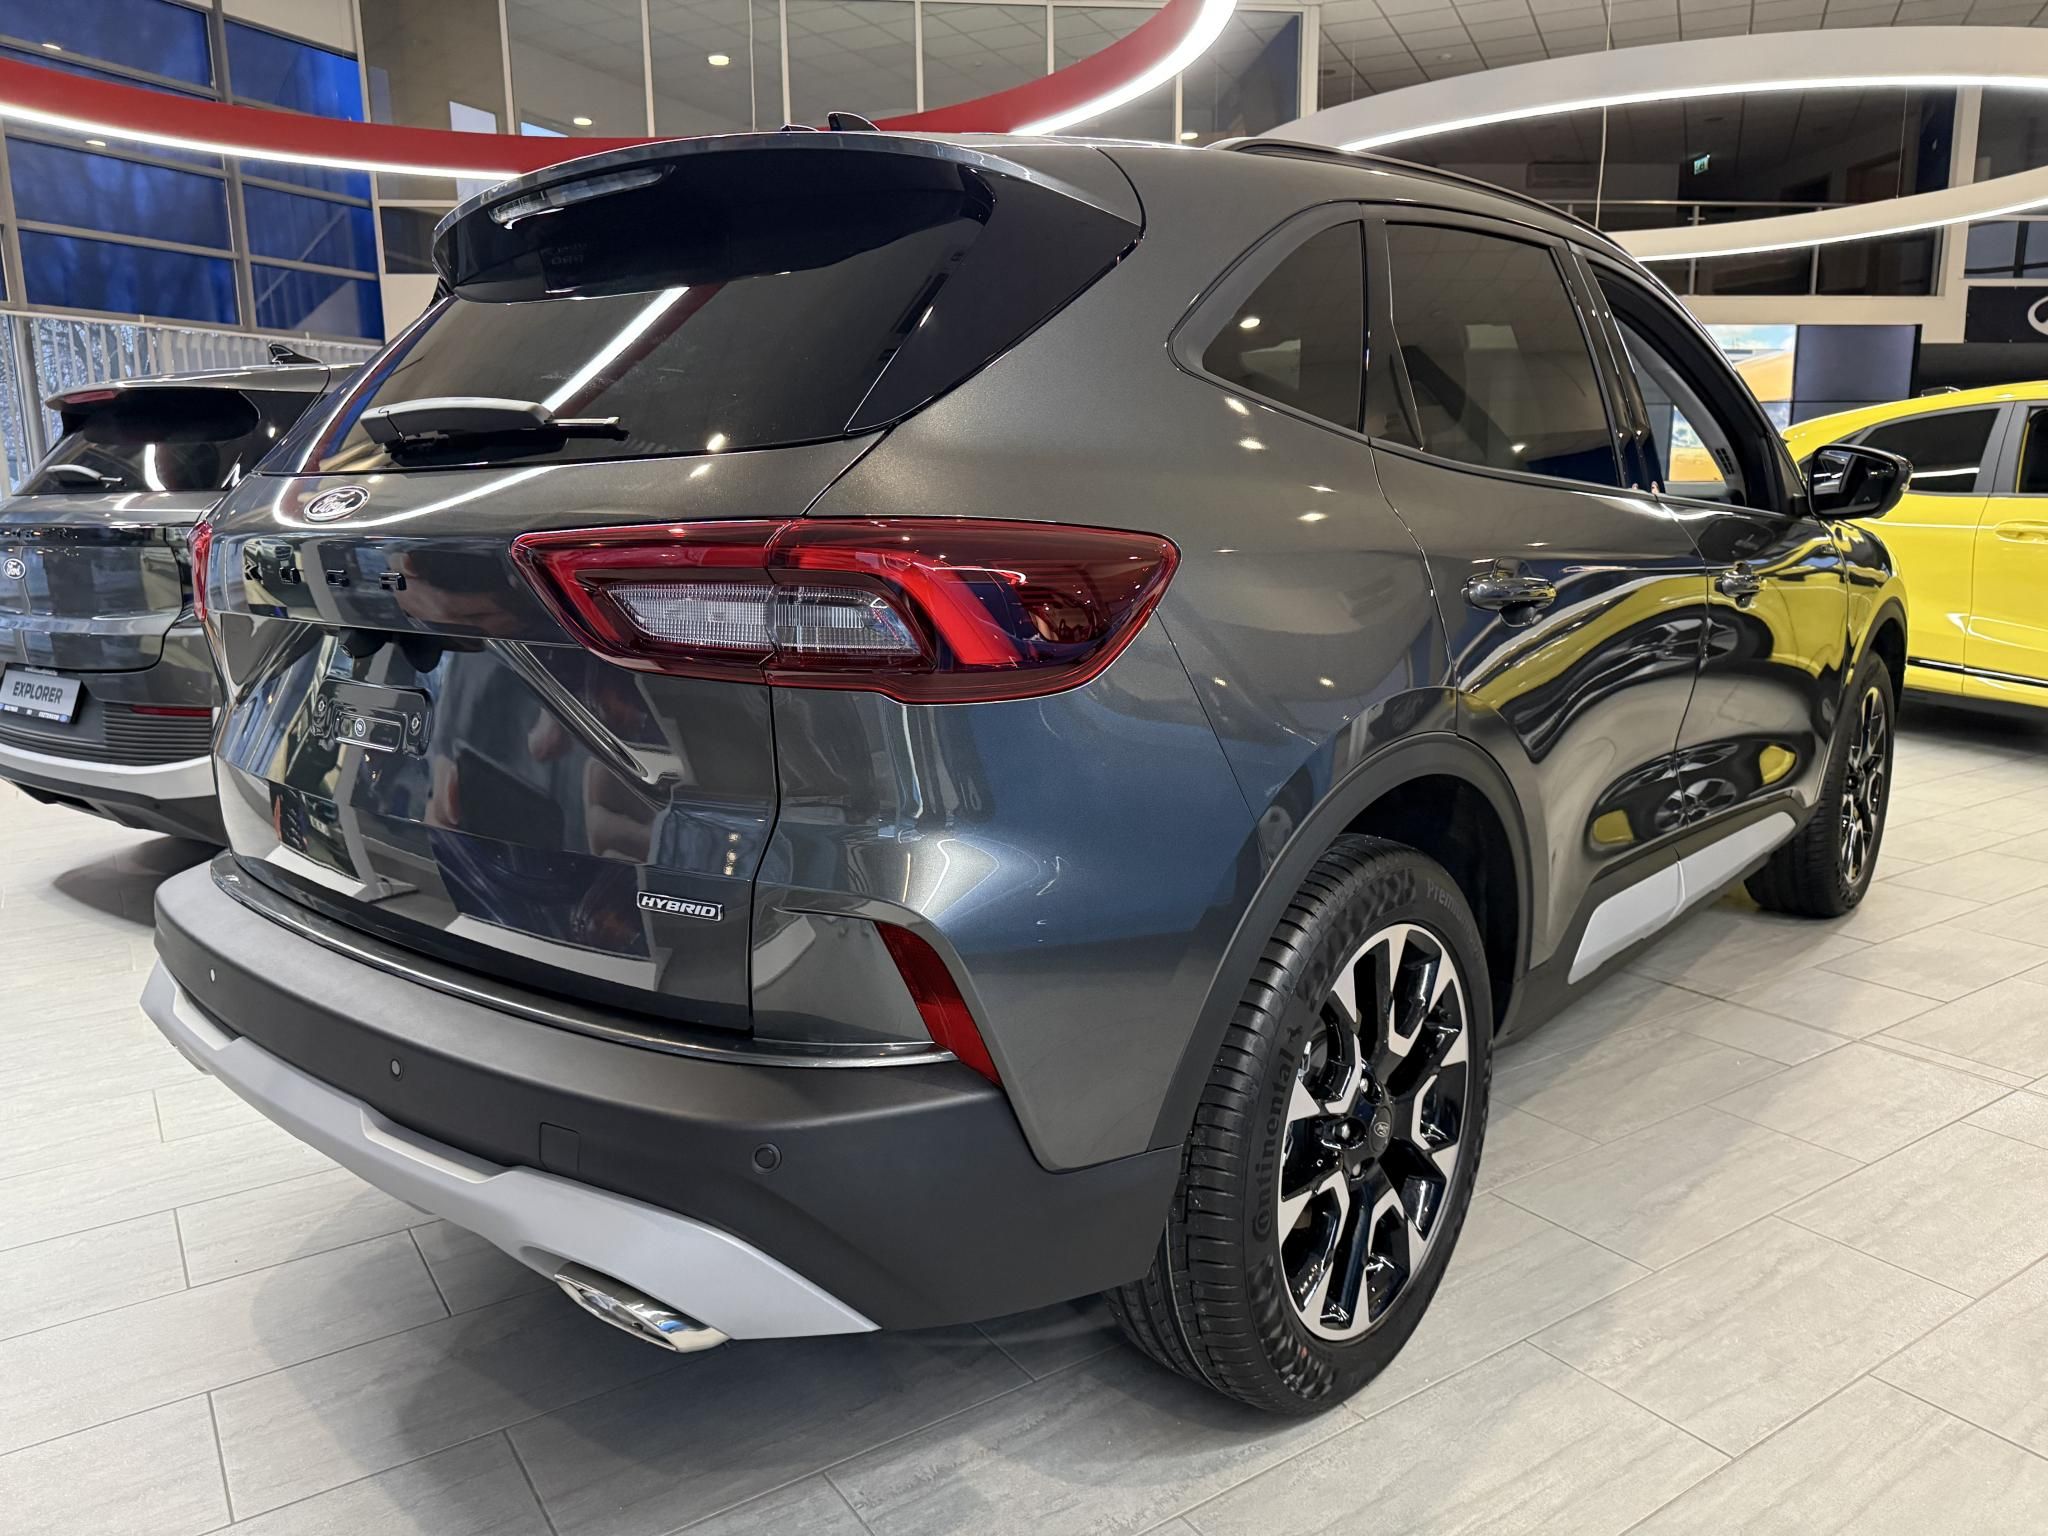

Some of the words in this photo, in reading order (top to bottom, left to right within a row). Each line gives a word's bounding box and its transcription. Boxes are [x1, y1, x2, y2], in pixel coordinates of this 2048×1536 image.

[13, 681, 63, 704] EXPLORER
[641, 895, 716, 917] HYBRID
[1252, 1047, 1297, 1243] Continental
